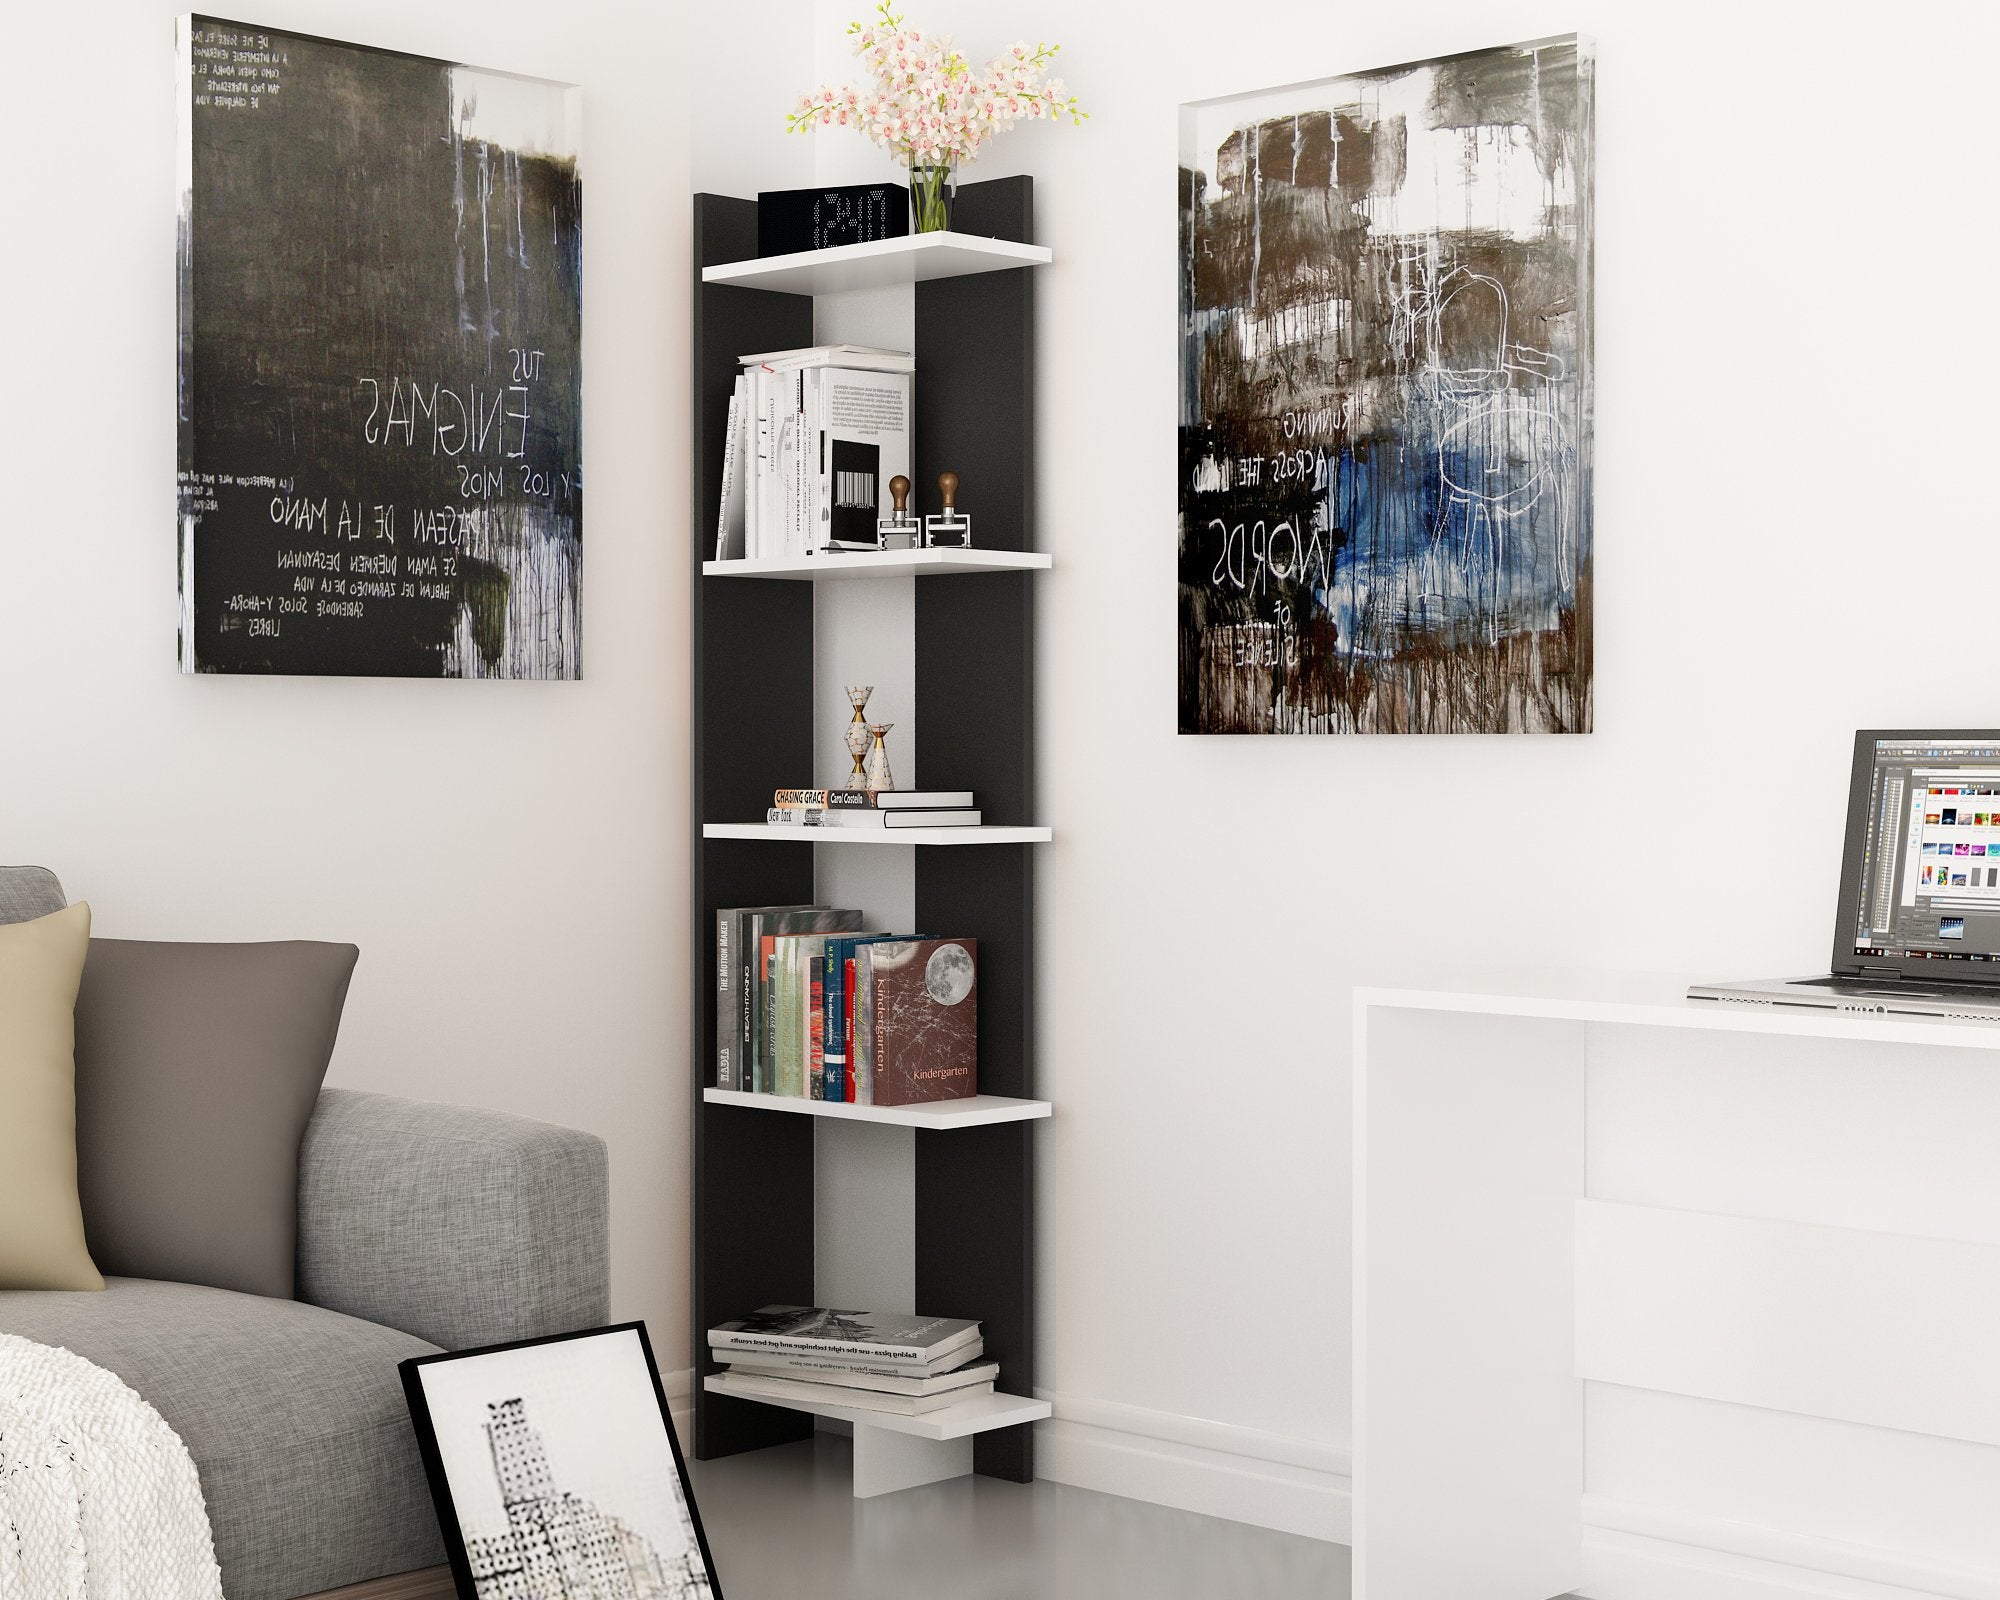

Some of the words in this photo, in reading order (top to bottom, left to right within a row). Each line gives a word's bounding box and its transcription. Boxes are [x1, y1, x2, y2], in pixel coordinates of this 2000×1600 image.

[776, 791, 803, 804] CHASING
[804, 792, 825, 805] GRACE
[830, 792, 843, 804] Carol
[720, 921, 728, 947] MAKER
[720, 948, 728, 977] MOTION
[826, 959, 834, 974] Shelly
[720, 978, 728, 992] THE
[876, 979, 886, 1072] Kindergarten
[913, 1066, 968, 1081] Kindergarten
